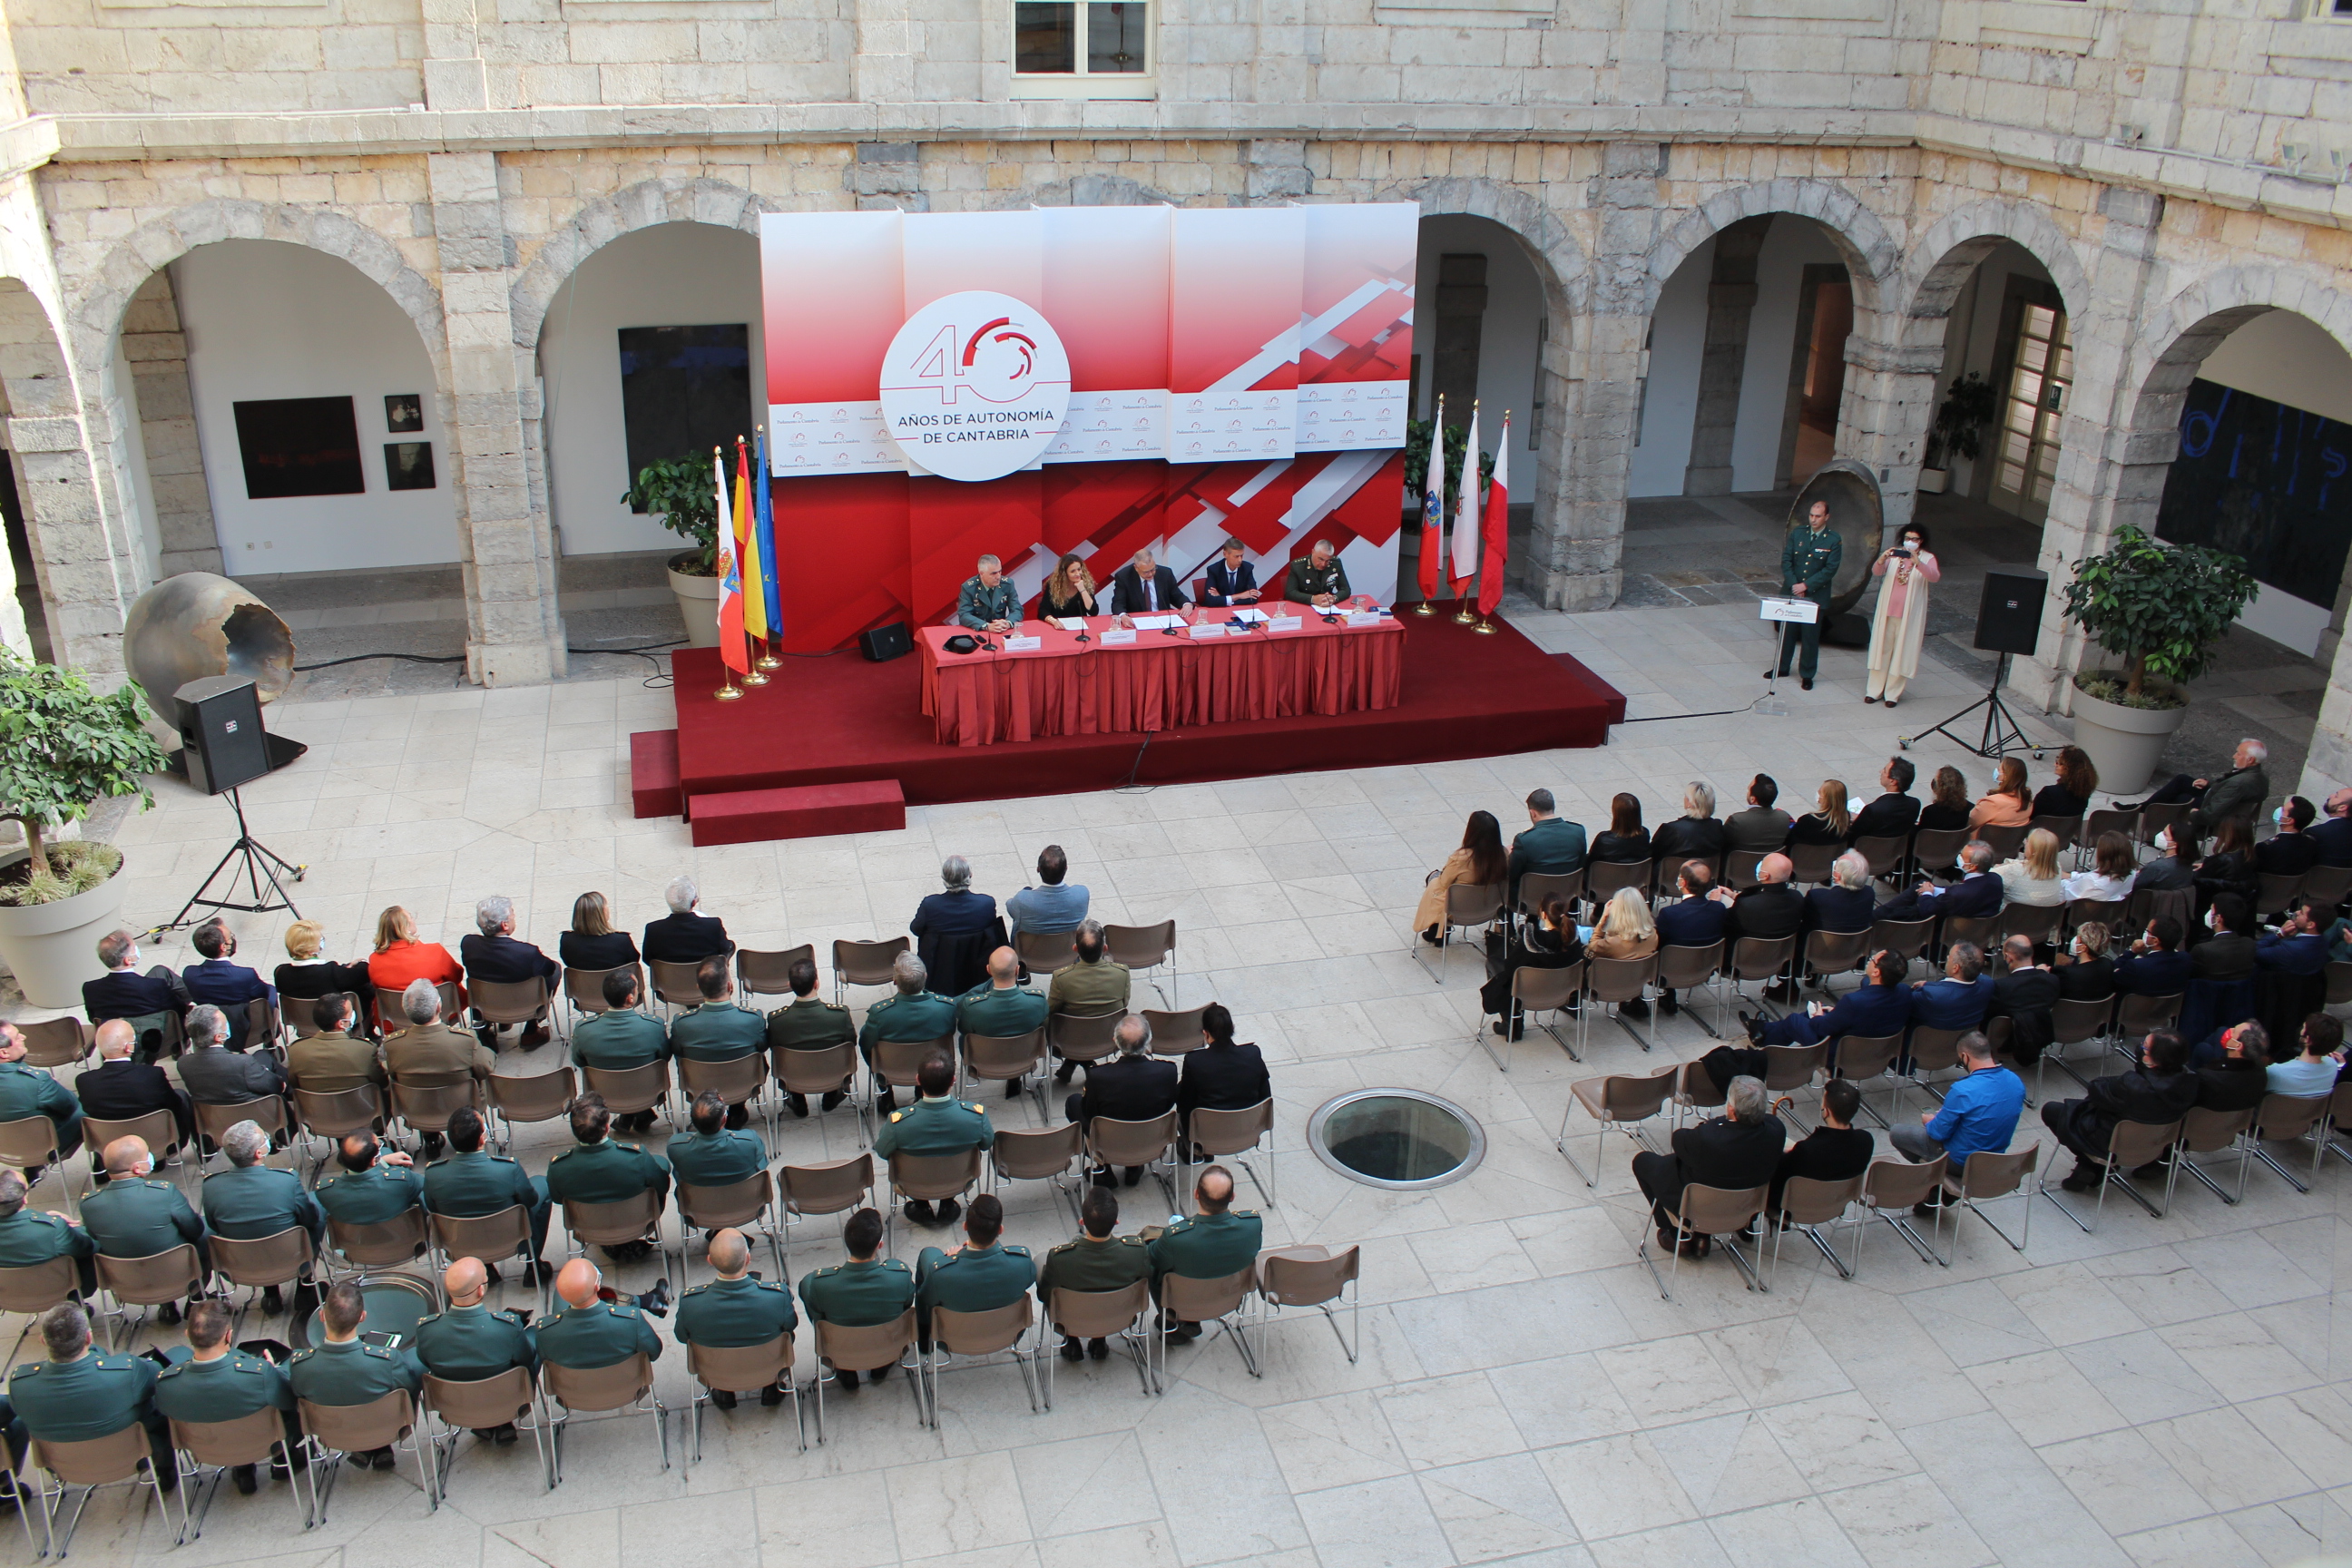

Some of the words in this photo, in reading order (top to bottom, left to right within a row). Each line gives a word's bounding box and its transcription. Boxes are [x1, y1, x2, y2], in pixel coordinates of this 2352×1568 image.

[909, 316, 1038, 405] 40
[897, 412, 939, 427] AÑOS
[943, 414, 962, 426] DE
[966, 407, 1054, 425] AUTONOMÍA
[923, 432, 943, 444] DE
[946, 428, 1030, 443] CANTABRIA
